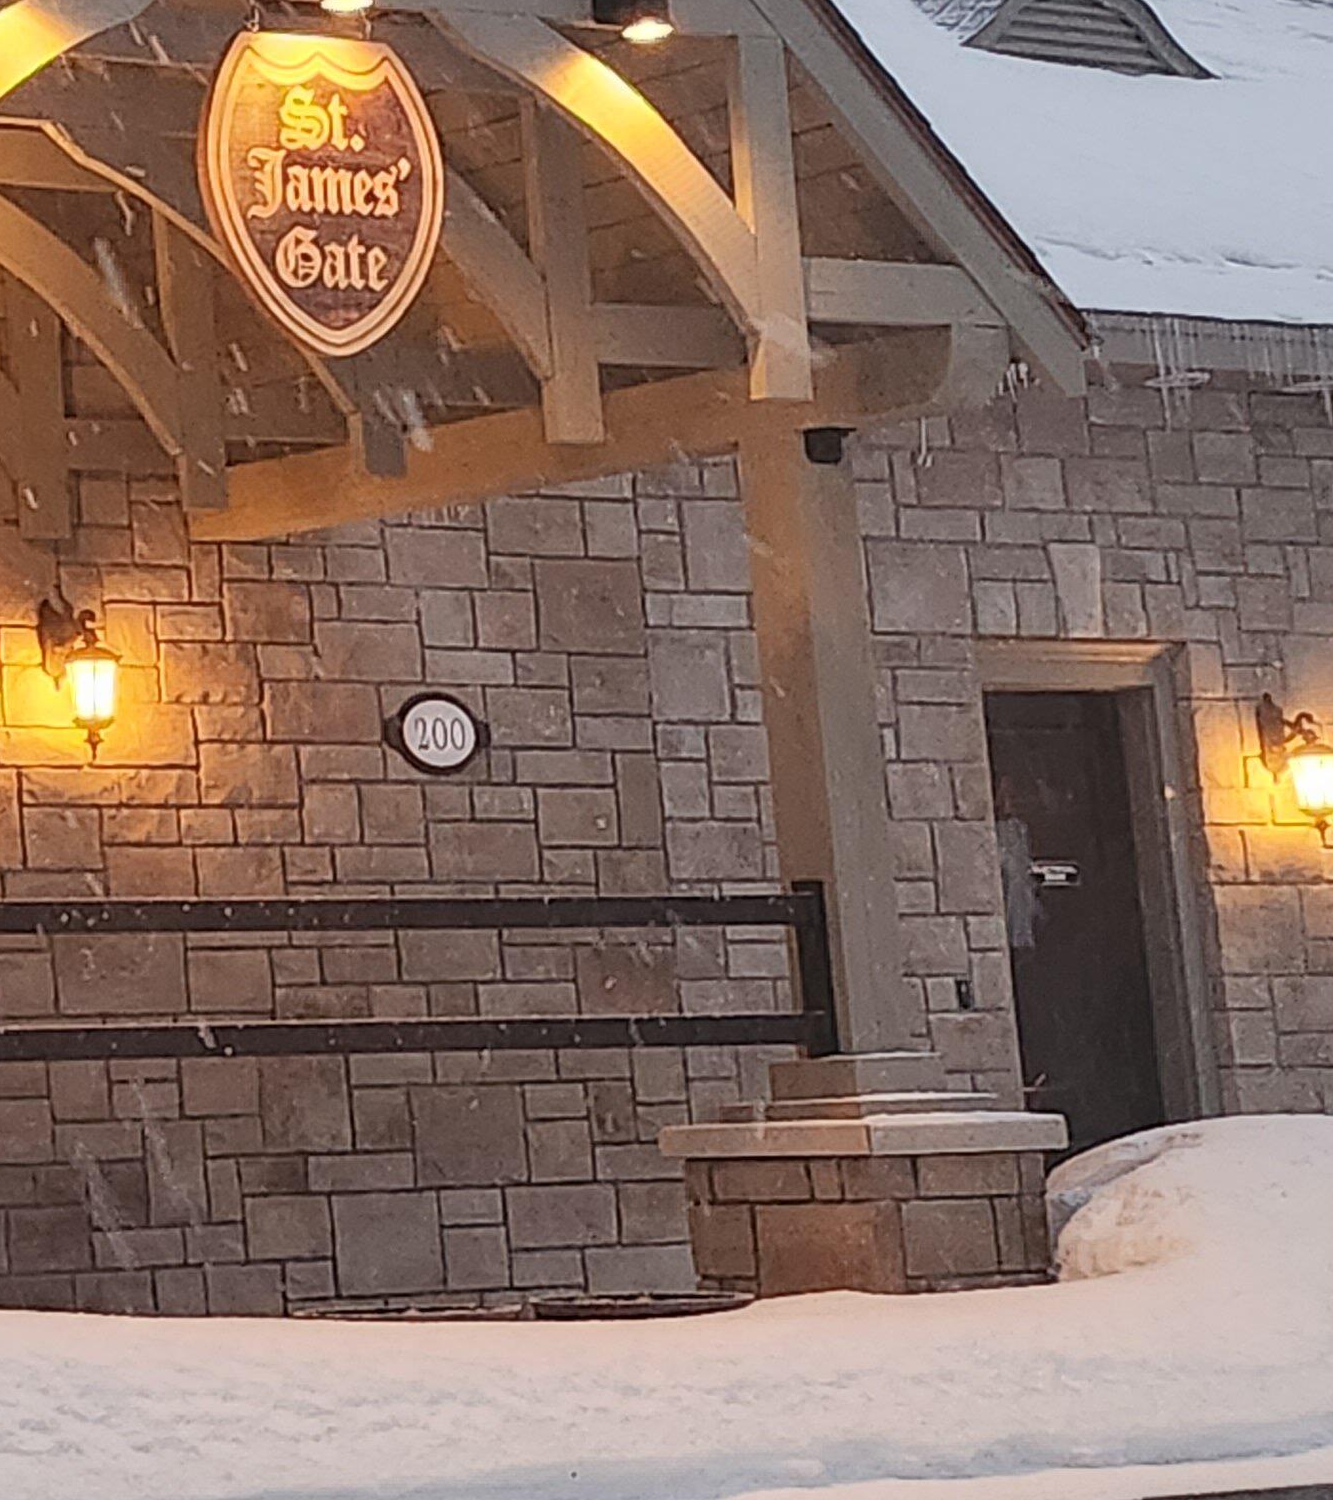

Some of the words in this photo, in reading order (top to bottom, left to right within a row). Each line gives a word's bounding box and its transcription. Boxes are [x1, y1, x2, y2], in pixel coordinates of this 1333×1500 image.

[278, 84, 366, 152] St.
[274, 225, 389, 292] Gate
[414, 716, 466, 751] 200
